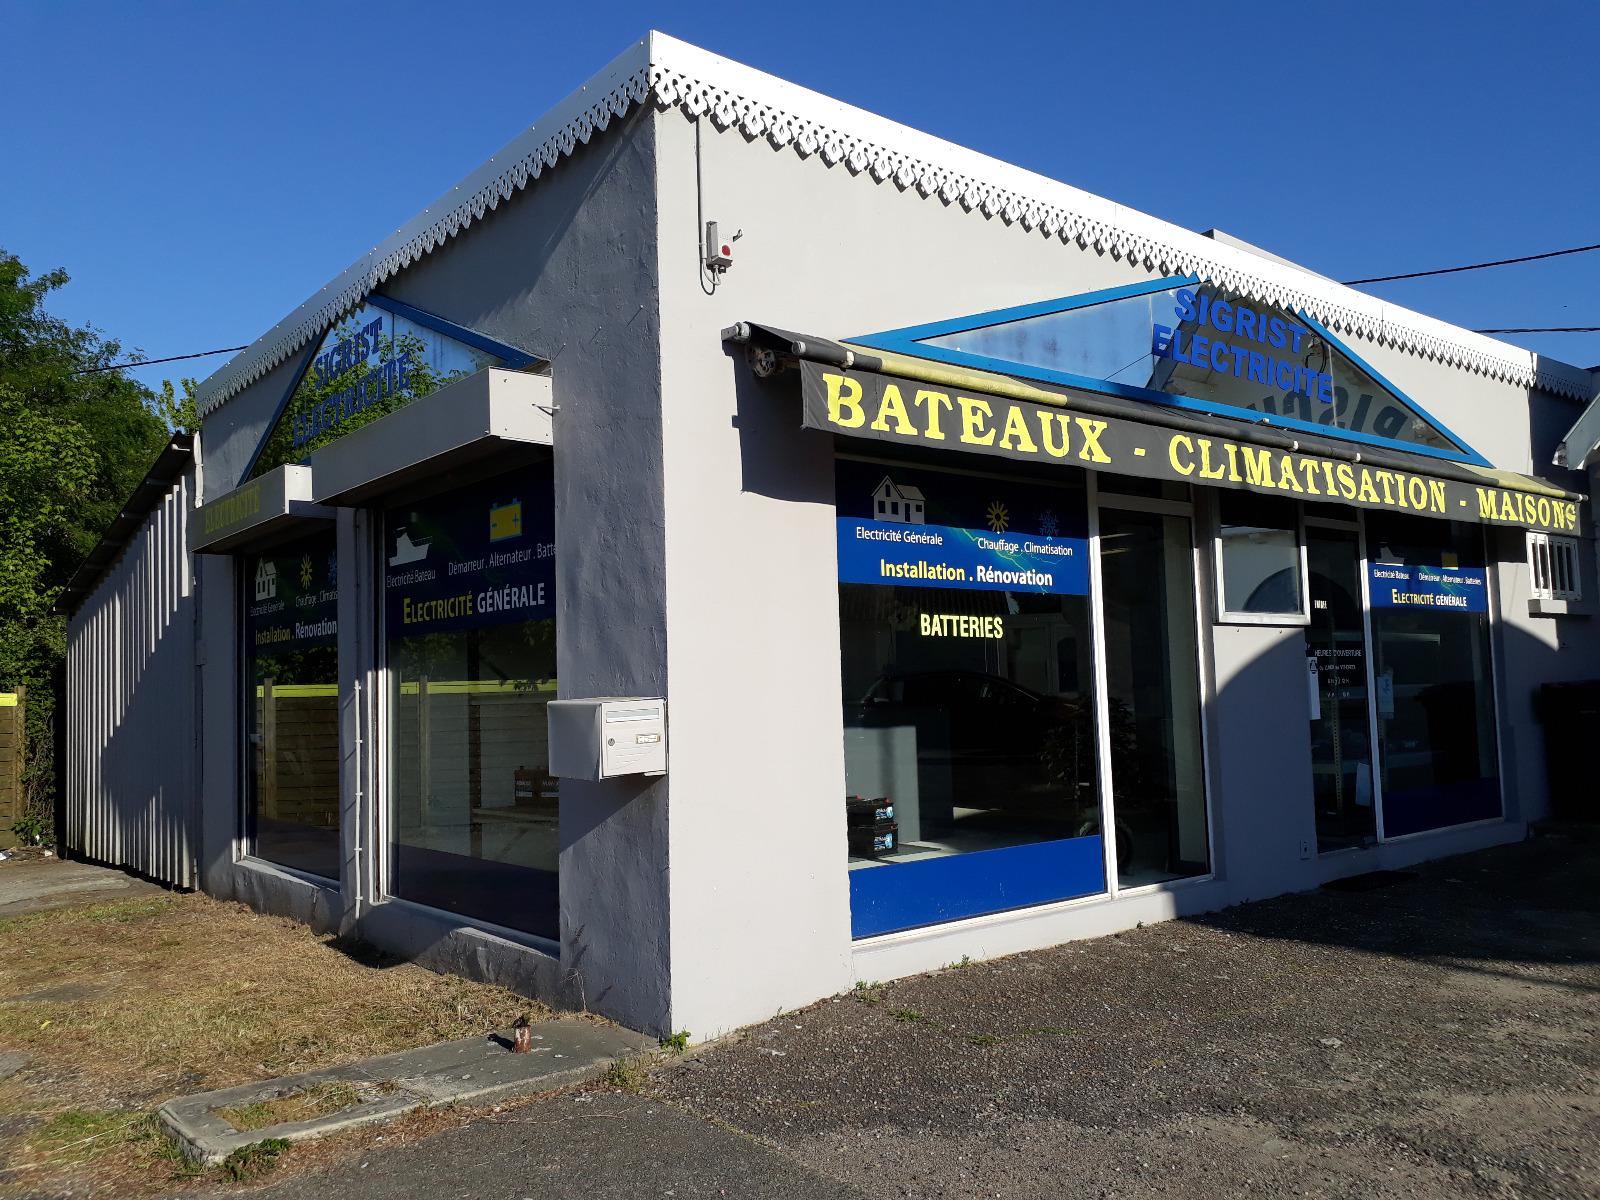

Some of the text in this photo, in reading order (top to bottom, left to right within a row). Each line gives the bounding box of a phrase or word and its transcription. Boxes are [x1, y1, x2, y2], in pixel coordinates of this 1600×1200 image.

[1174, 287, 1308, 354] SIGRIST
[314, 316, 383, 390] SIGRIST
[1151, 322, 1334, 404] ELECTRICITE
[822, 372, 1112, 464] BATEAUX
[1168, 434, 1446, 514] CLIMATISATION
[1475, 488, 1577, 531] MAISONS
[856, 526, 943, 545] Electricité Générale
[977, 537, 1019, 553] Chauffage
[1024, 540, 1073, 556] Climatisation
[448, 557, 485, 576] Démarreur
[489, 549, 532, 567] Alternateur
[880, 558, 966, 581] Installation
[976, 564, 1053, 586] Rénovation
[477, 582, 546, 614] GÉNÉRALE
[255, 625, 291, 646] Installation
[295, 617, 337, 639] Rénovation
[920, 613, 1003, 639] BATTERIES
